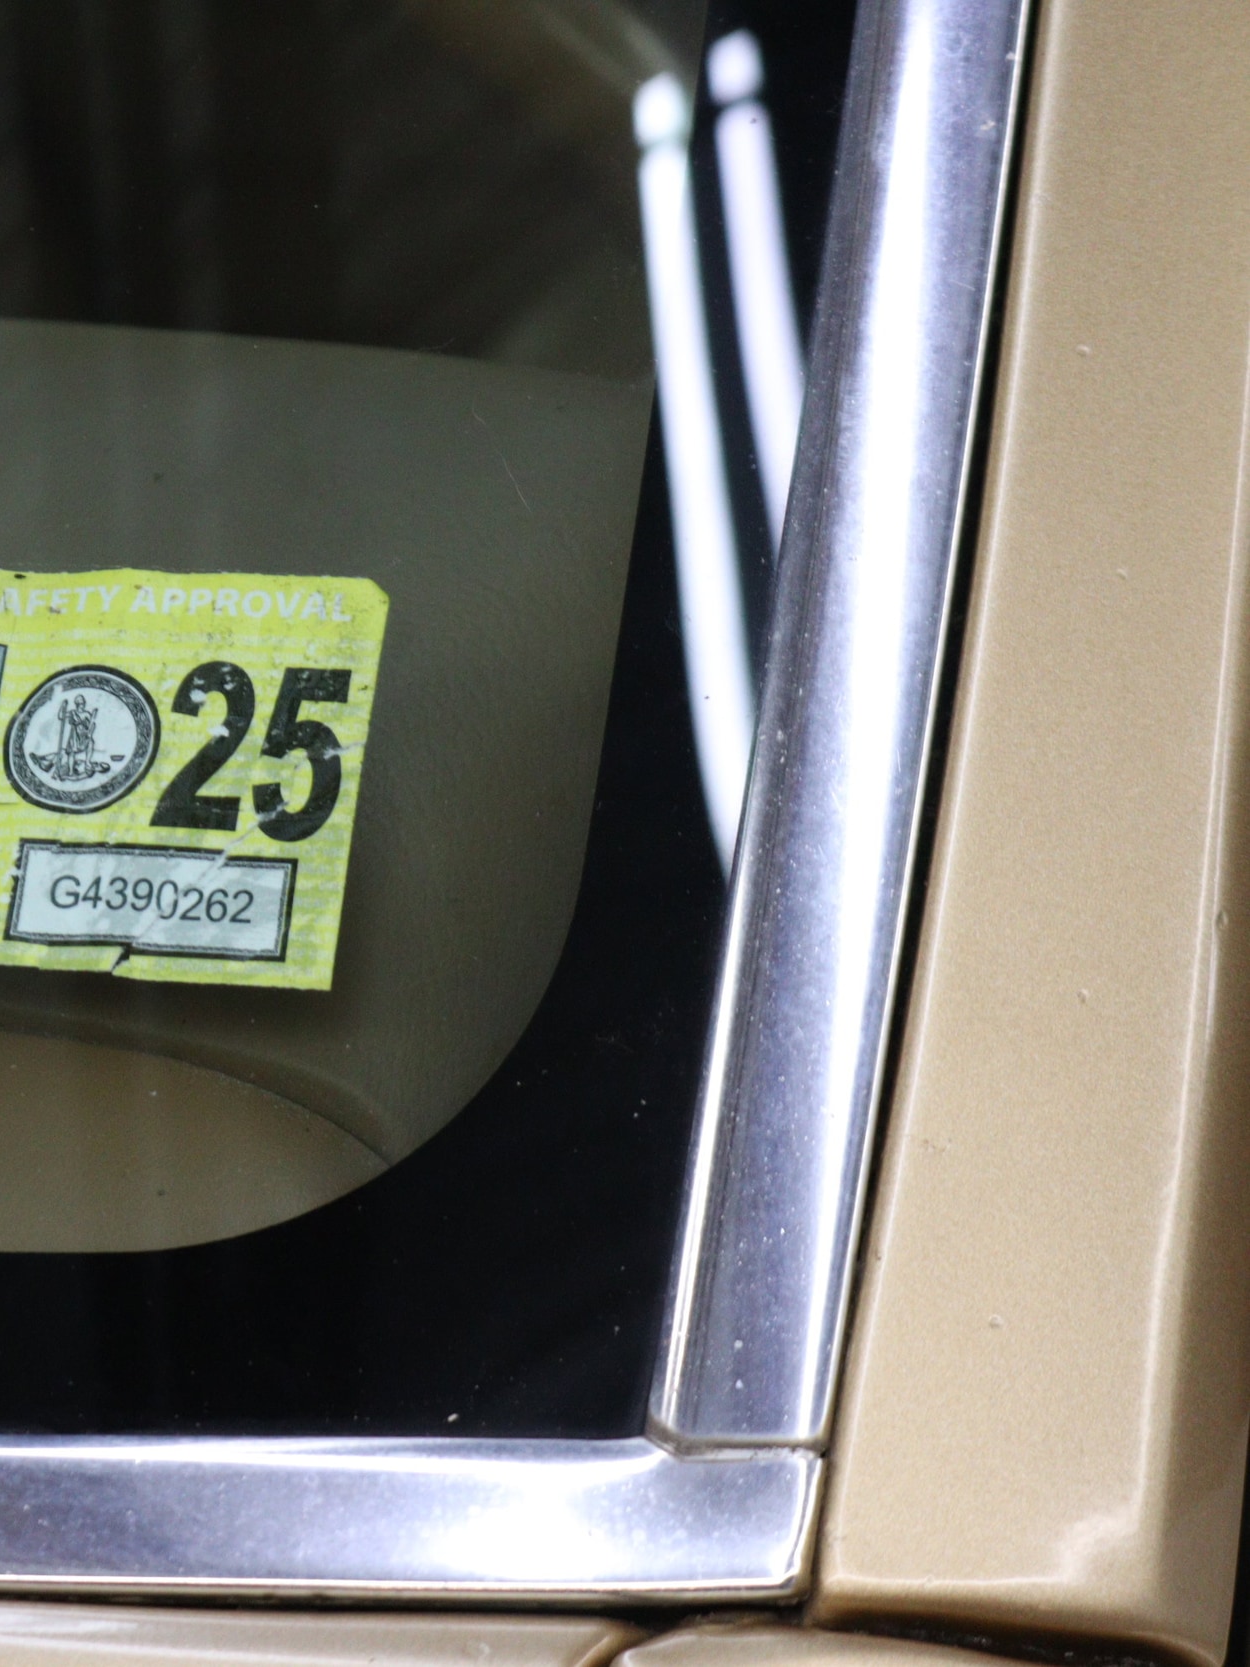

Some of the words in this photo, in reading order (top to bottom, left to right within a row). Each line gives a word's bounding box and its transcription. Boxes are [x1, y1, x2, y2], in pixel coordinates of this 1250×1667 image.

[129, 586, 353, 622] APPROVAL
[149, 661, 352, 842] 25
[50, 874, 254, 924] G4390262
